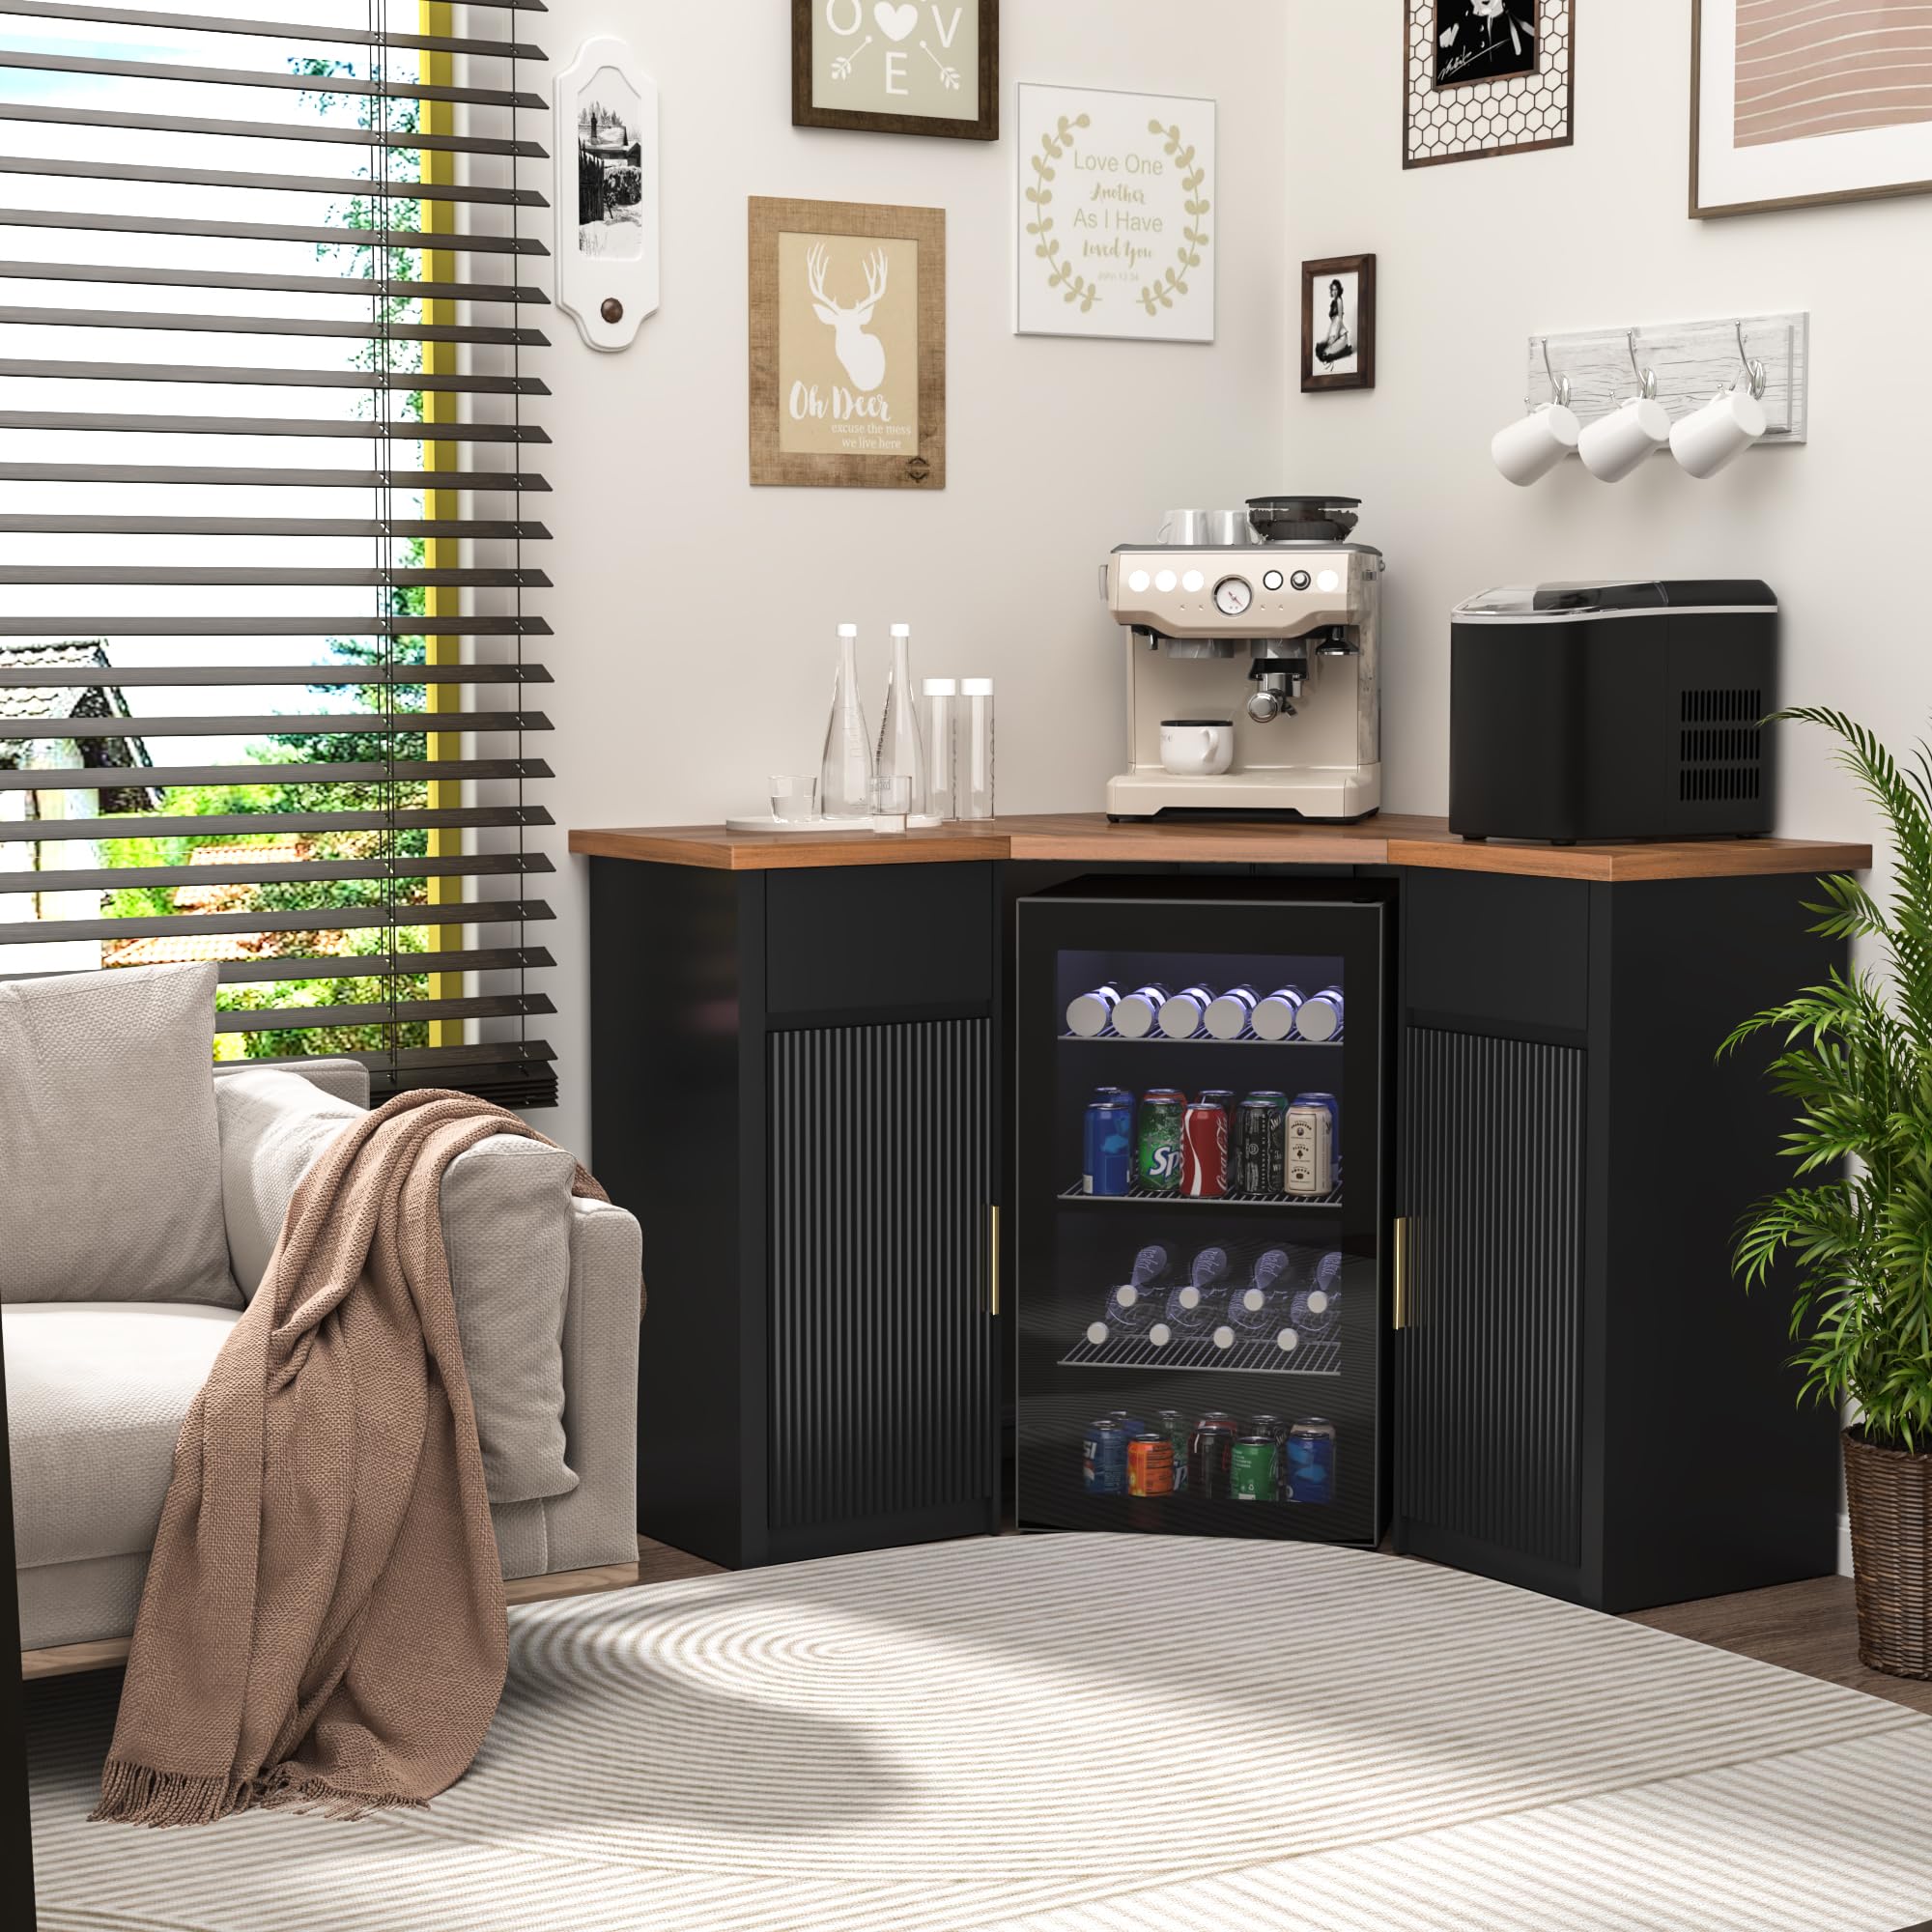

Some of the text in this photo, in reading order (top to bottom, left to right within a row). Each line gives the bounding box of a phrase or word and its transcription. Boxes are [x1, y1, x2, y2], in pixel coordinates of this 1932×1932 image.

[1074, 150, 1163, 175] Love One
[1090, 182, 1147, 205] Another
[1073, 208, 1098, 229] As
[1116, 209, 1163, 233] Have
[788, 380, 891, 422] Oh Deer
[831, 422, 912, 436] excuse the mess
[841, 437, 902, 449] we live here
